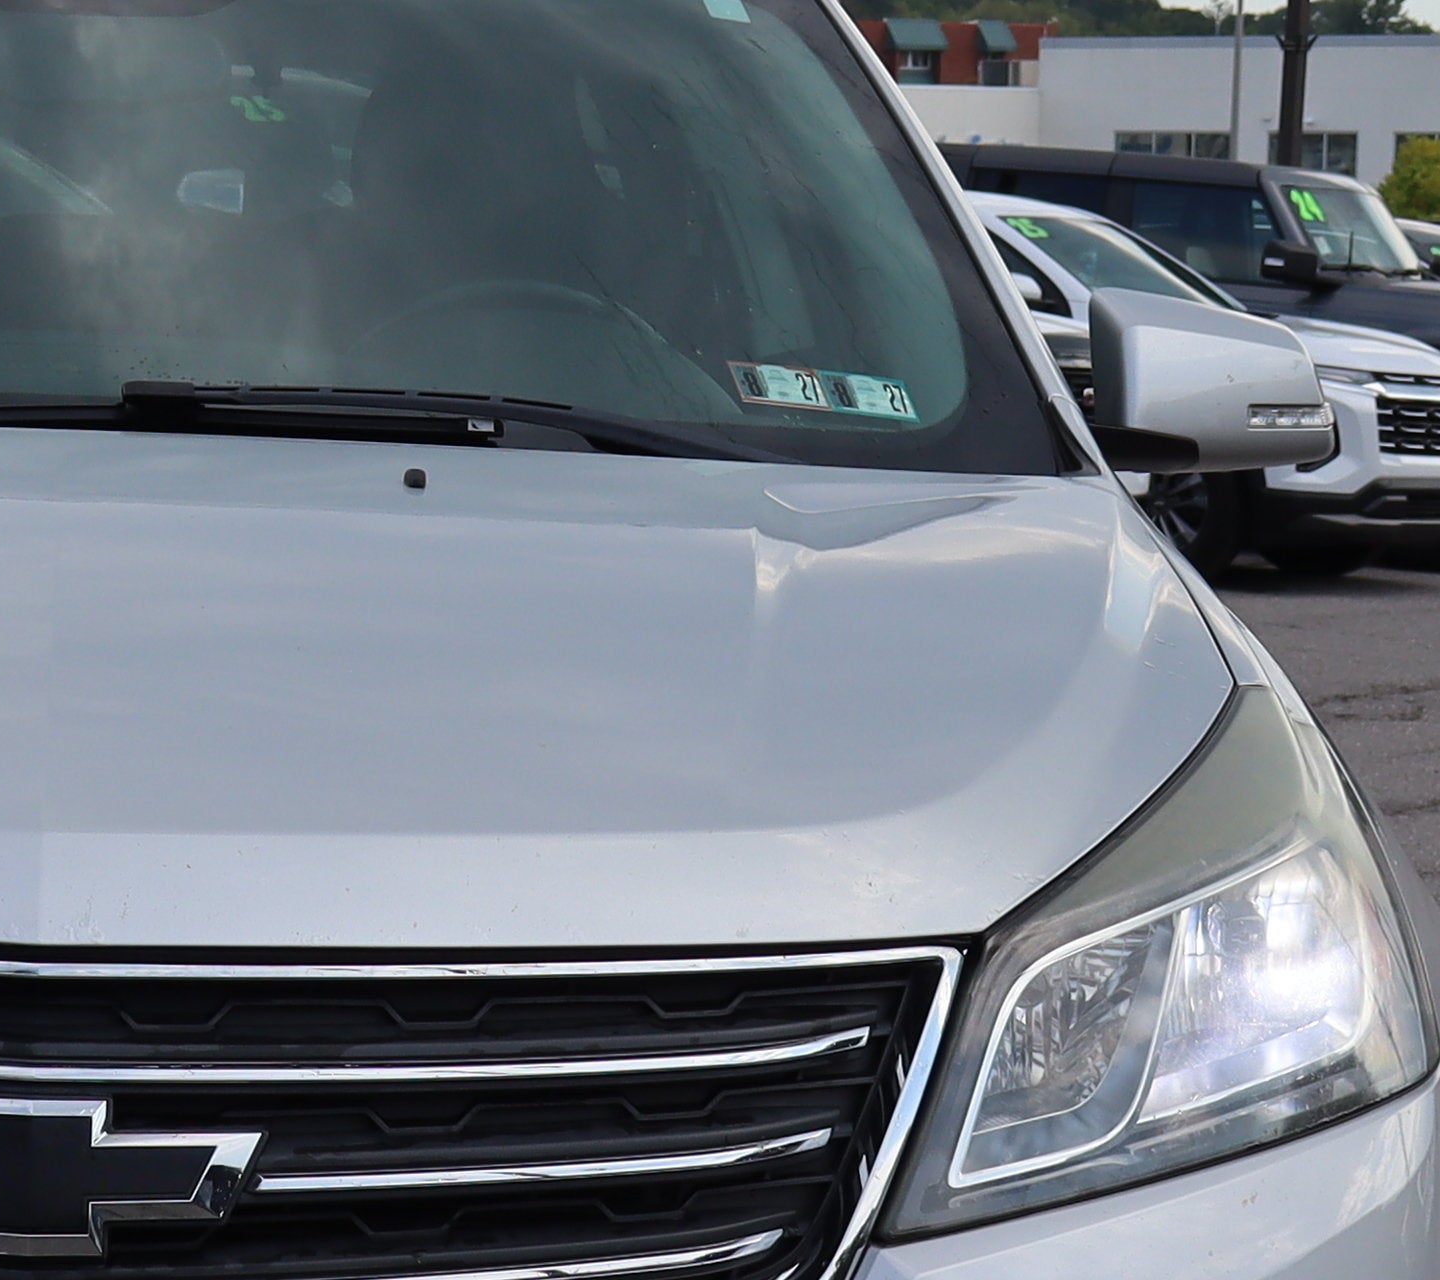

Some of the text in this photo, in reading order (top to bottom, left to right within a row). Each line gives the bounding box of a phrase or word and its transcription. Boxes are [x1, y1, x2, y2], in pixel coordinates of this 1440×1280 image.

[742, 371, 820, 405] 8 27
[833, 381, 909, 415] 8 27
